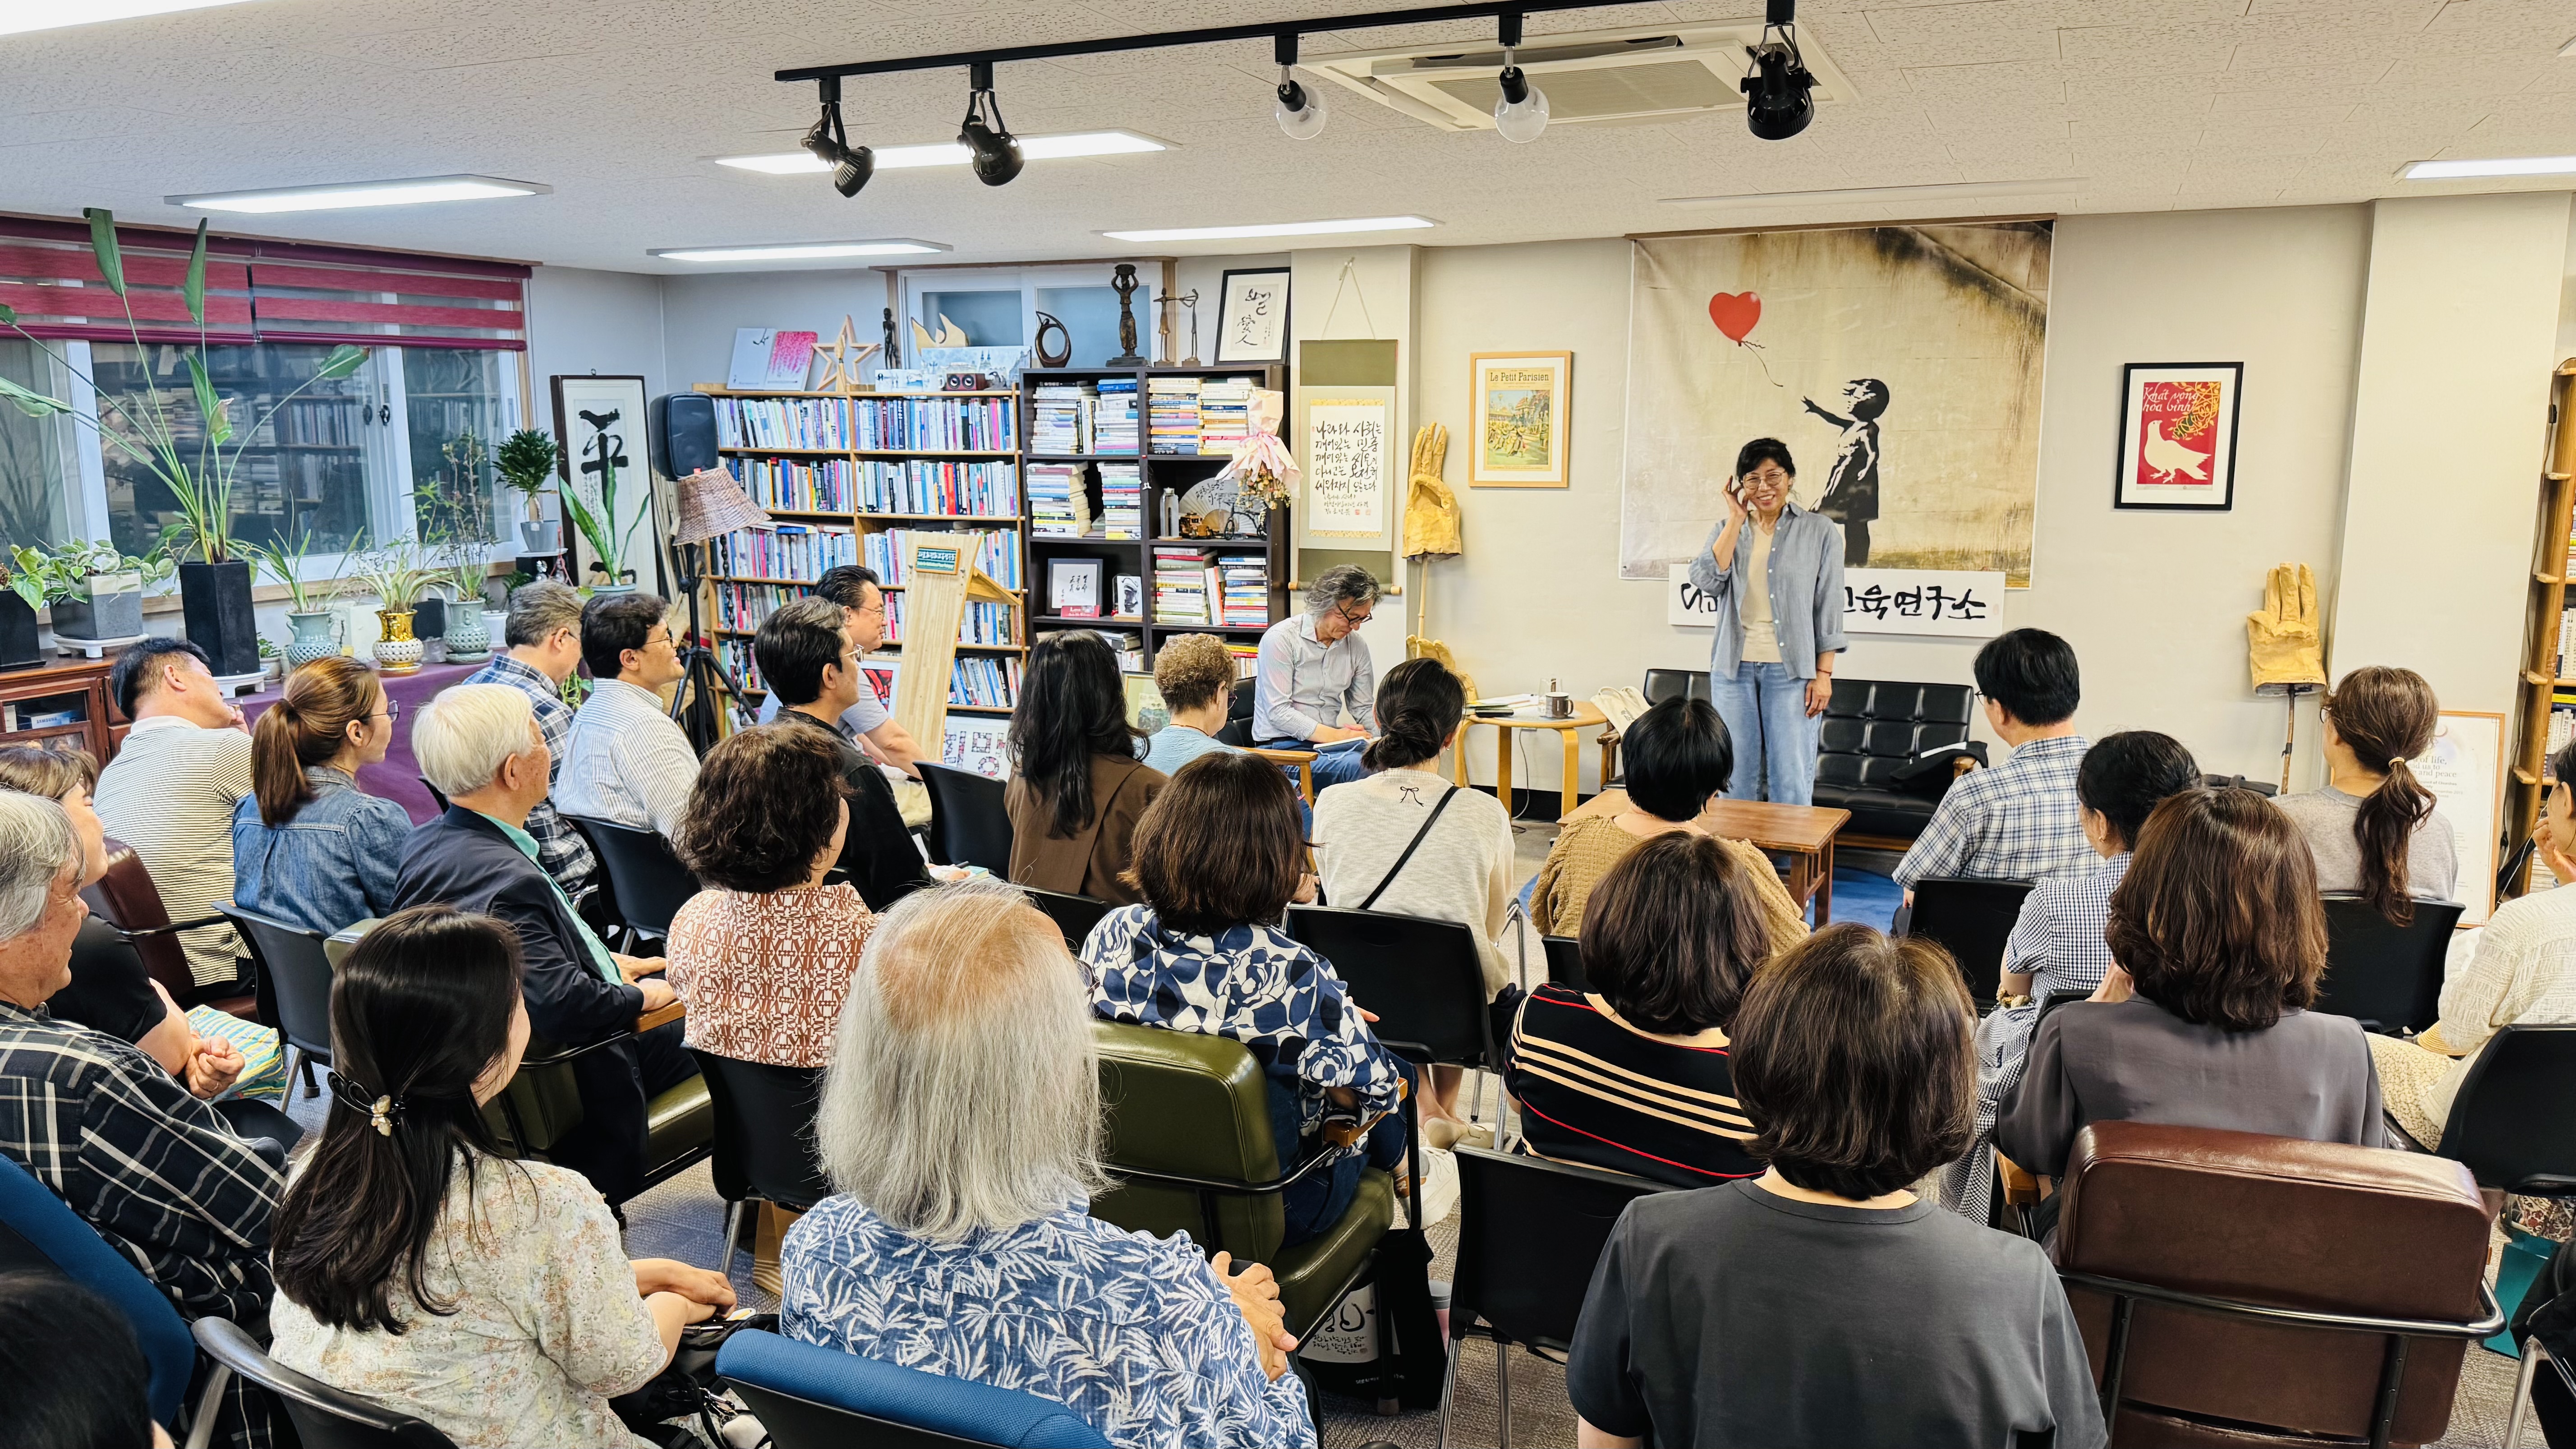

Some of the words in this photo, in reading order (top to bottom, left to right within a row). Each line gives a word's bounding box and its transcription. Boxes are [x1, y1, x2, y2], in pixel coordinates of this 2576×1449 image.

[1490, 373, 1498, 381] Le
[1501, 373, 1516, 381] Petit
[1518, 372, 1549, 381] Parisien
[1316, 421, 1350, 440] 나라와
[1353, 421, 1382, 438] 사회는
[1357, 437, 1378, 452] 민중
[2431, 756, 2447, 765] life,
